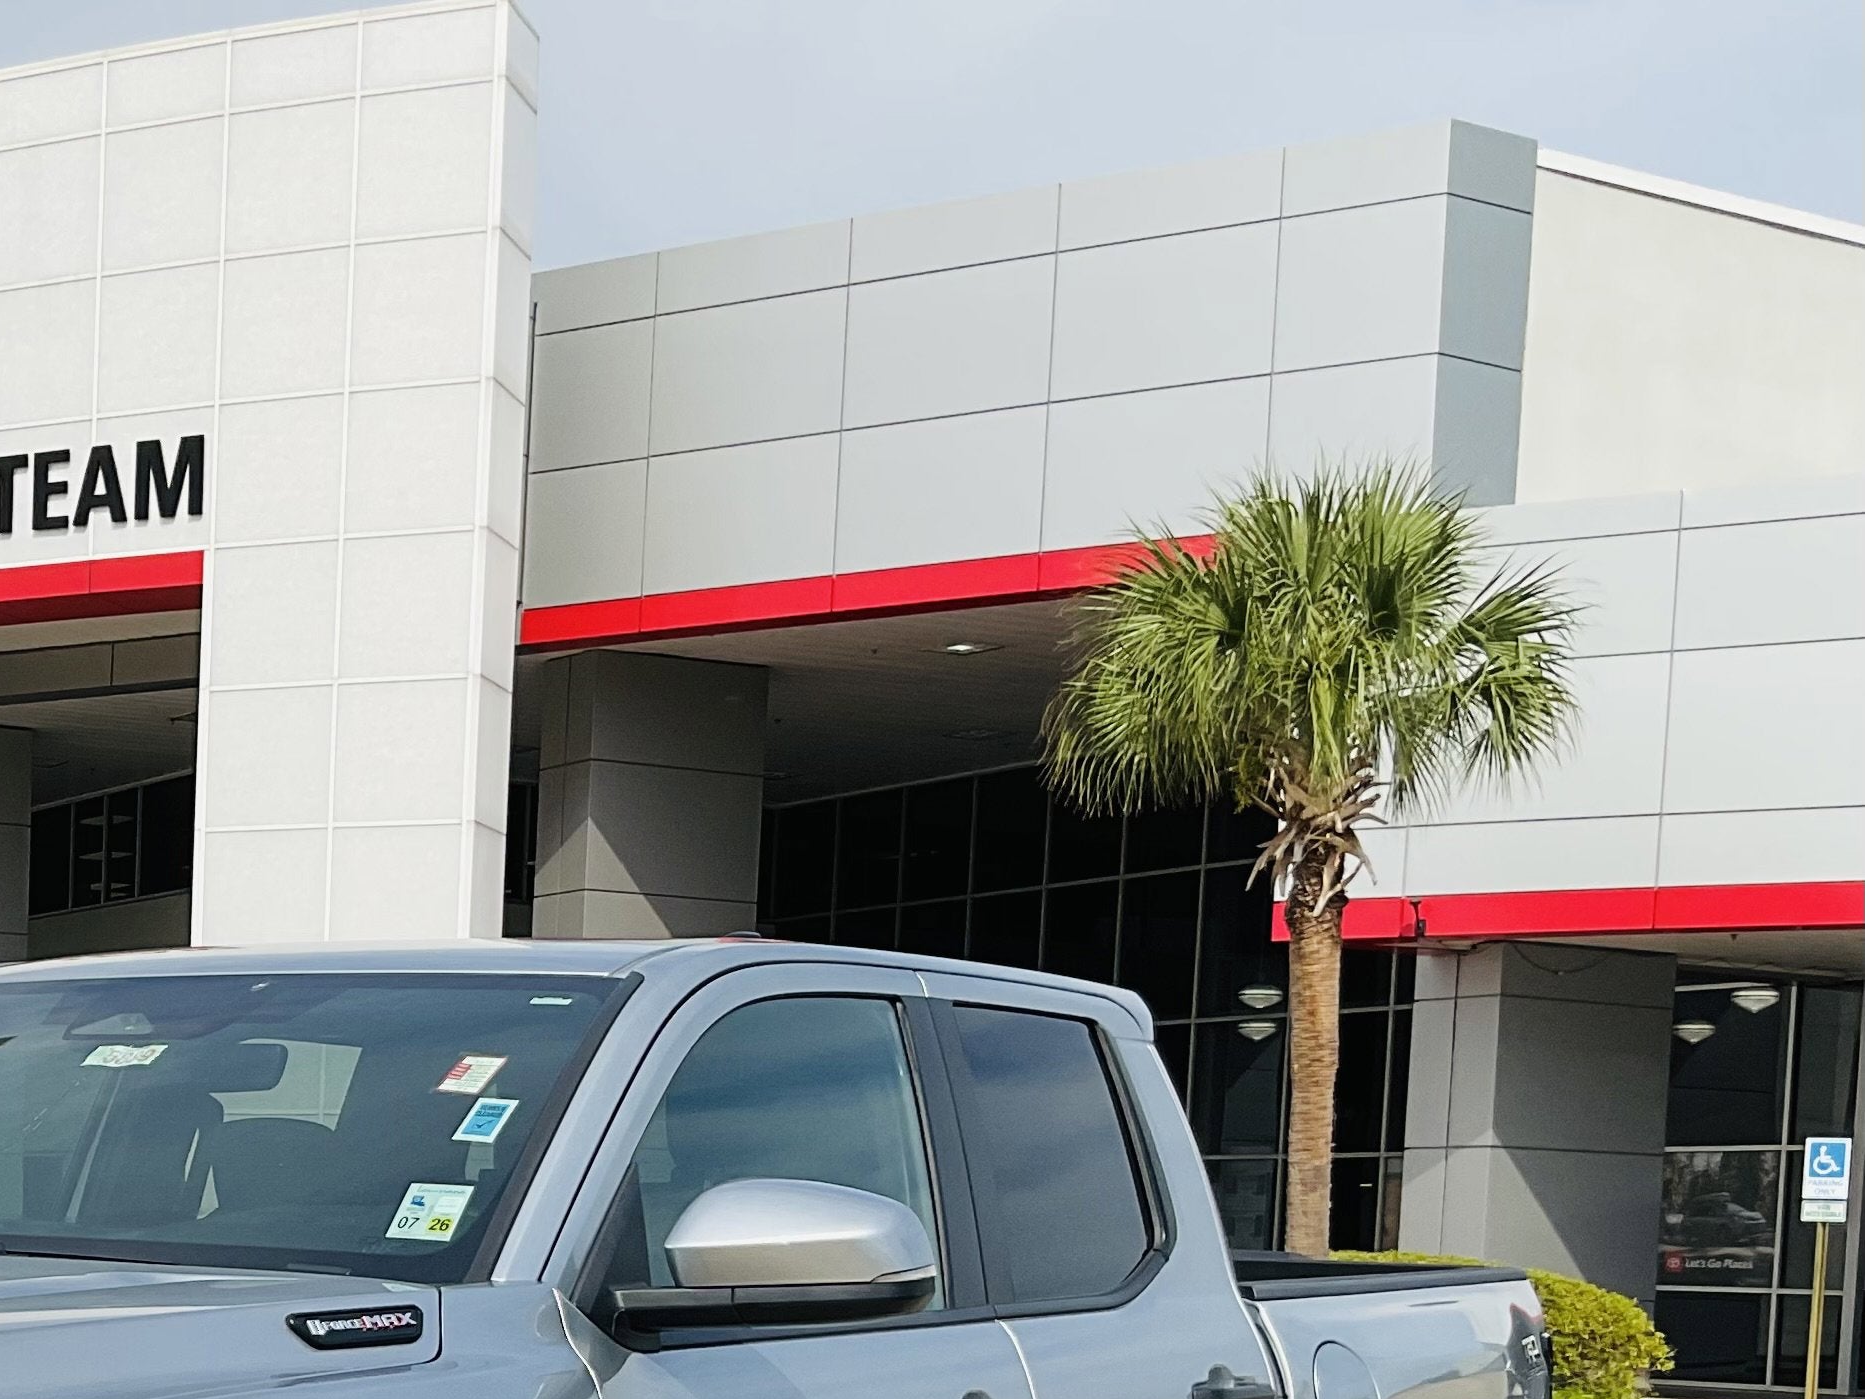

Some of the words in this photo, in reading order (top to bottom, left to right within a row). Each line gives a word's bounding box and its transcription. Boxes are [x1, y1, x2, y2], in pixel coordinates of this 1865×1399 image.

[397, 1216, 420, 1229] 07
[428, 1218, 453, 1232] 26
[361, 1312, 417, 1331] MAX
